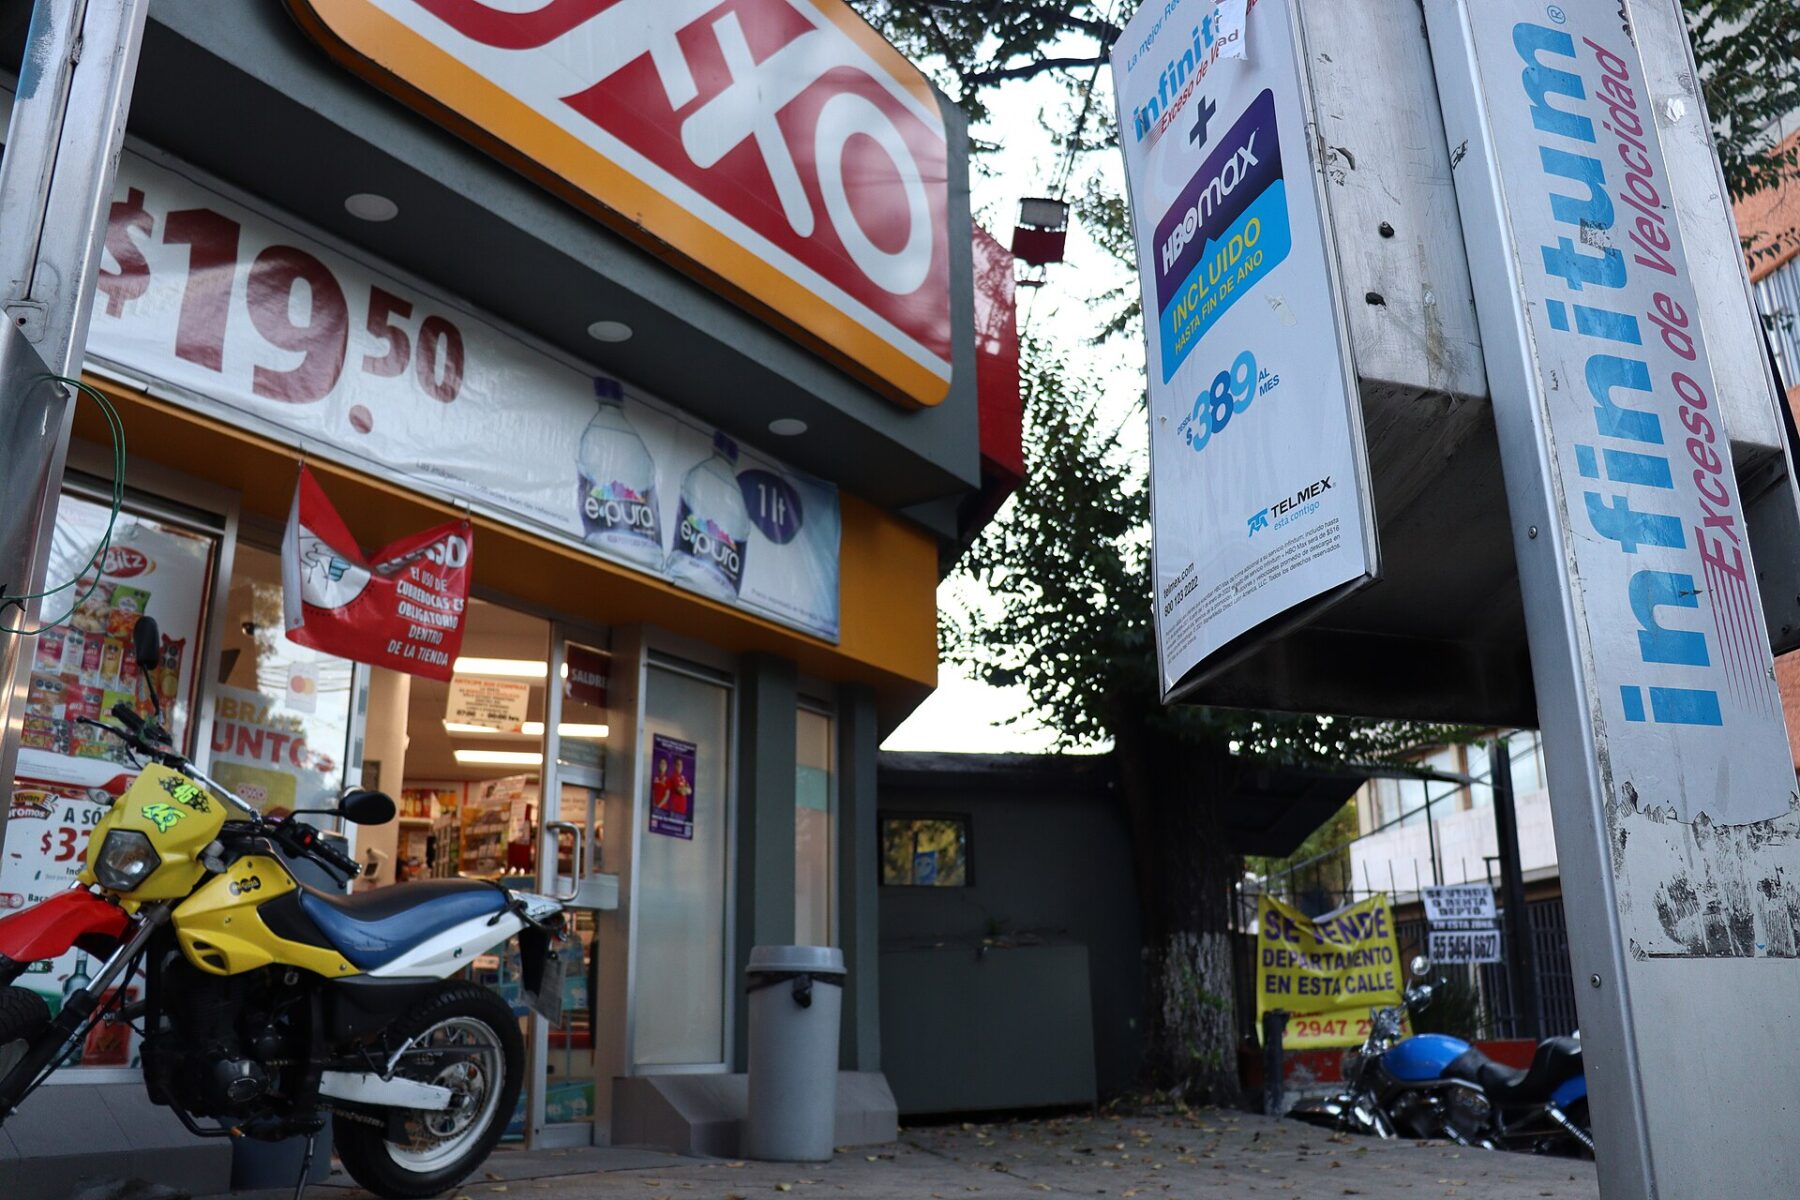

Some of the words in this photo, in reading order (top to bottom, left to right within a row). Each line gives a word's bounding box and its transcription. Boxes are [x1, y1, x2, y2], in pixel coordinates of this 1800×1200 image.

[1160, 79, 1195, 133] Exceso
[1196, 60, 1209, 86] de
[1582, 36, 1678, 277] Velocidad
[1173, 217, 1261, 334] INCLUIDO
[1175, 316, 1201, 355] HASTA
[1202, 297, 1217, 320] FIN
[1219, 281, 1235, 302] DE
[1237, 249, 1263, 285] AÑO
[1646, 291, 1698, 361] de
[1258, 367, 1270, 383] AL
[1259, 374, 1280, 397] MES
[1512, 22, 1723, 727] infinitum
[1671, 371, 1746, 583] Exceso
[1271, 476, 1331, 519] TELMEX
[1274, 517, 1290, 531] está
[1291, 501, 1320, 522] contigo
[1325, 517, 1339, 528] hasta
[102, 550, 144, 574] Bitz
[410, 566, 419, 581] EL
[434, 577, 447, 592] DE
[398, 601, 458, 629] OBLIGATORIO
[452, 597, 464, 612] ES
[408, 625, 443, 645] DENTRO
[387, 639, 401, 655] DE
[404, 643, 415, 658] LA
[418, 648, 449, 667] TIENDA
[63, 807, 75, 823] A
[1264, 909, 1300, 943] SE
[1265, 974, 1291, 994] EN
[1297, 976, 1341, 996] ESTA
[1345, 971, 1394, 994] CALLE
[1295, 1018, 1348, 1038] 2947
